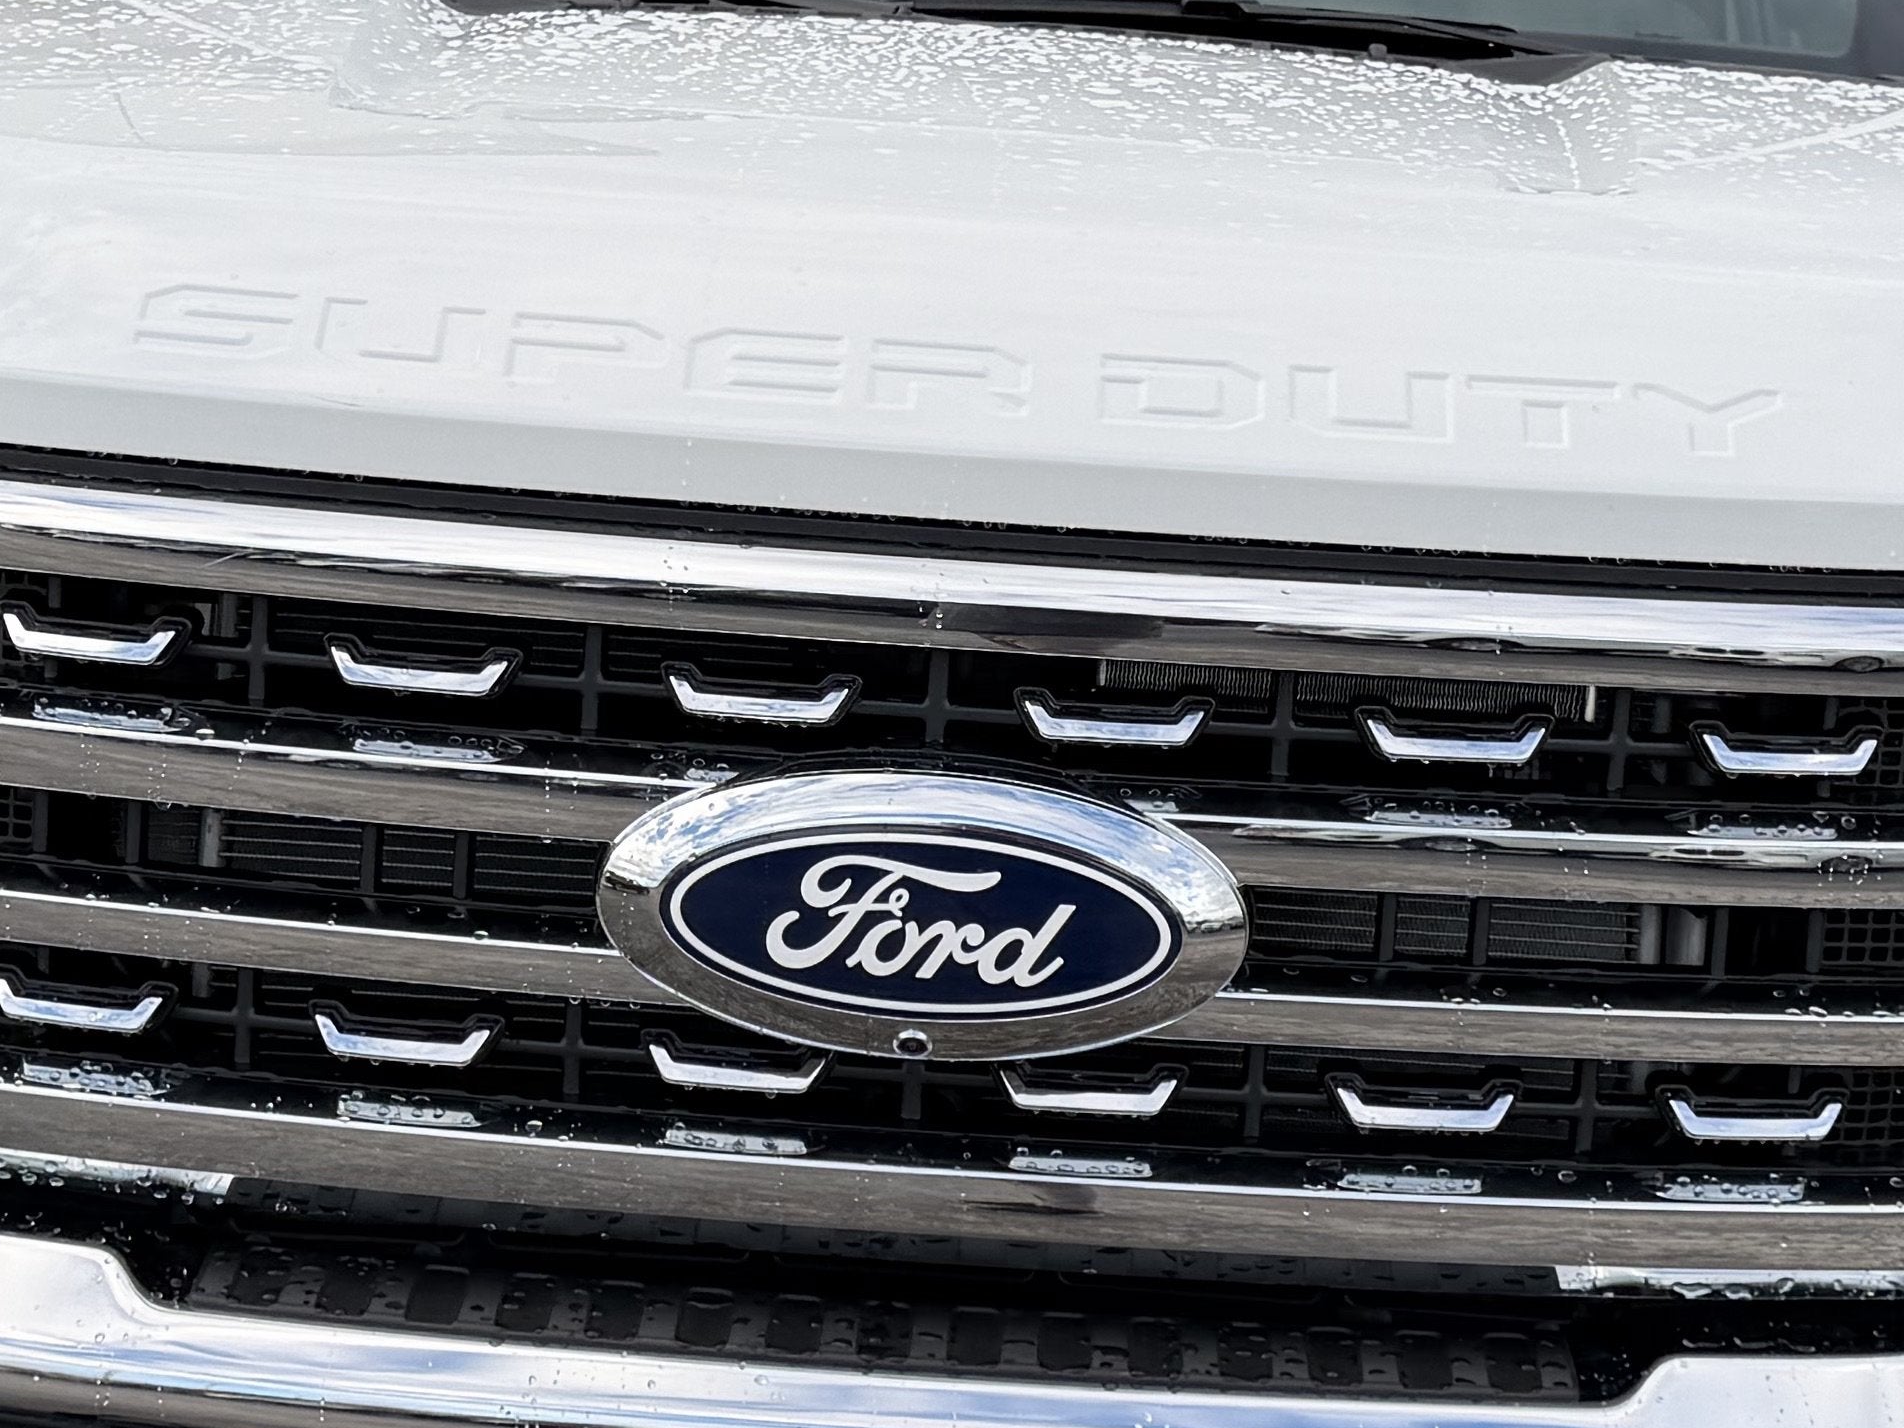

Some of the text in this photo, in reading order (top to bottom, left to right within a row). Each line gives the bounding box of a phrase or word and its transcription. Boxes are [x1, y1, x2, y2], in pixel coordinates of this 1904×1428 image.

[130, 282, 1783, 457] SUPER DUTY
[765, 854, 1077, 988] Ford
